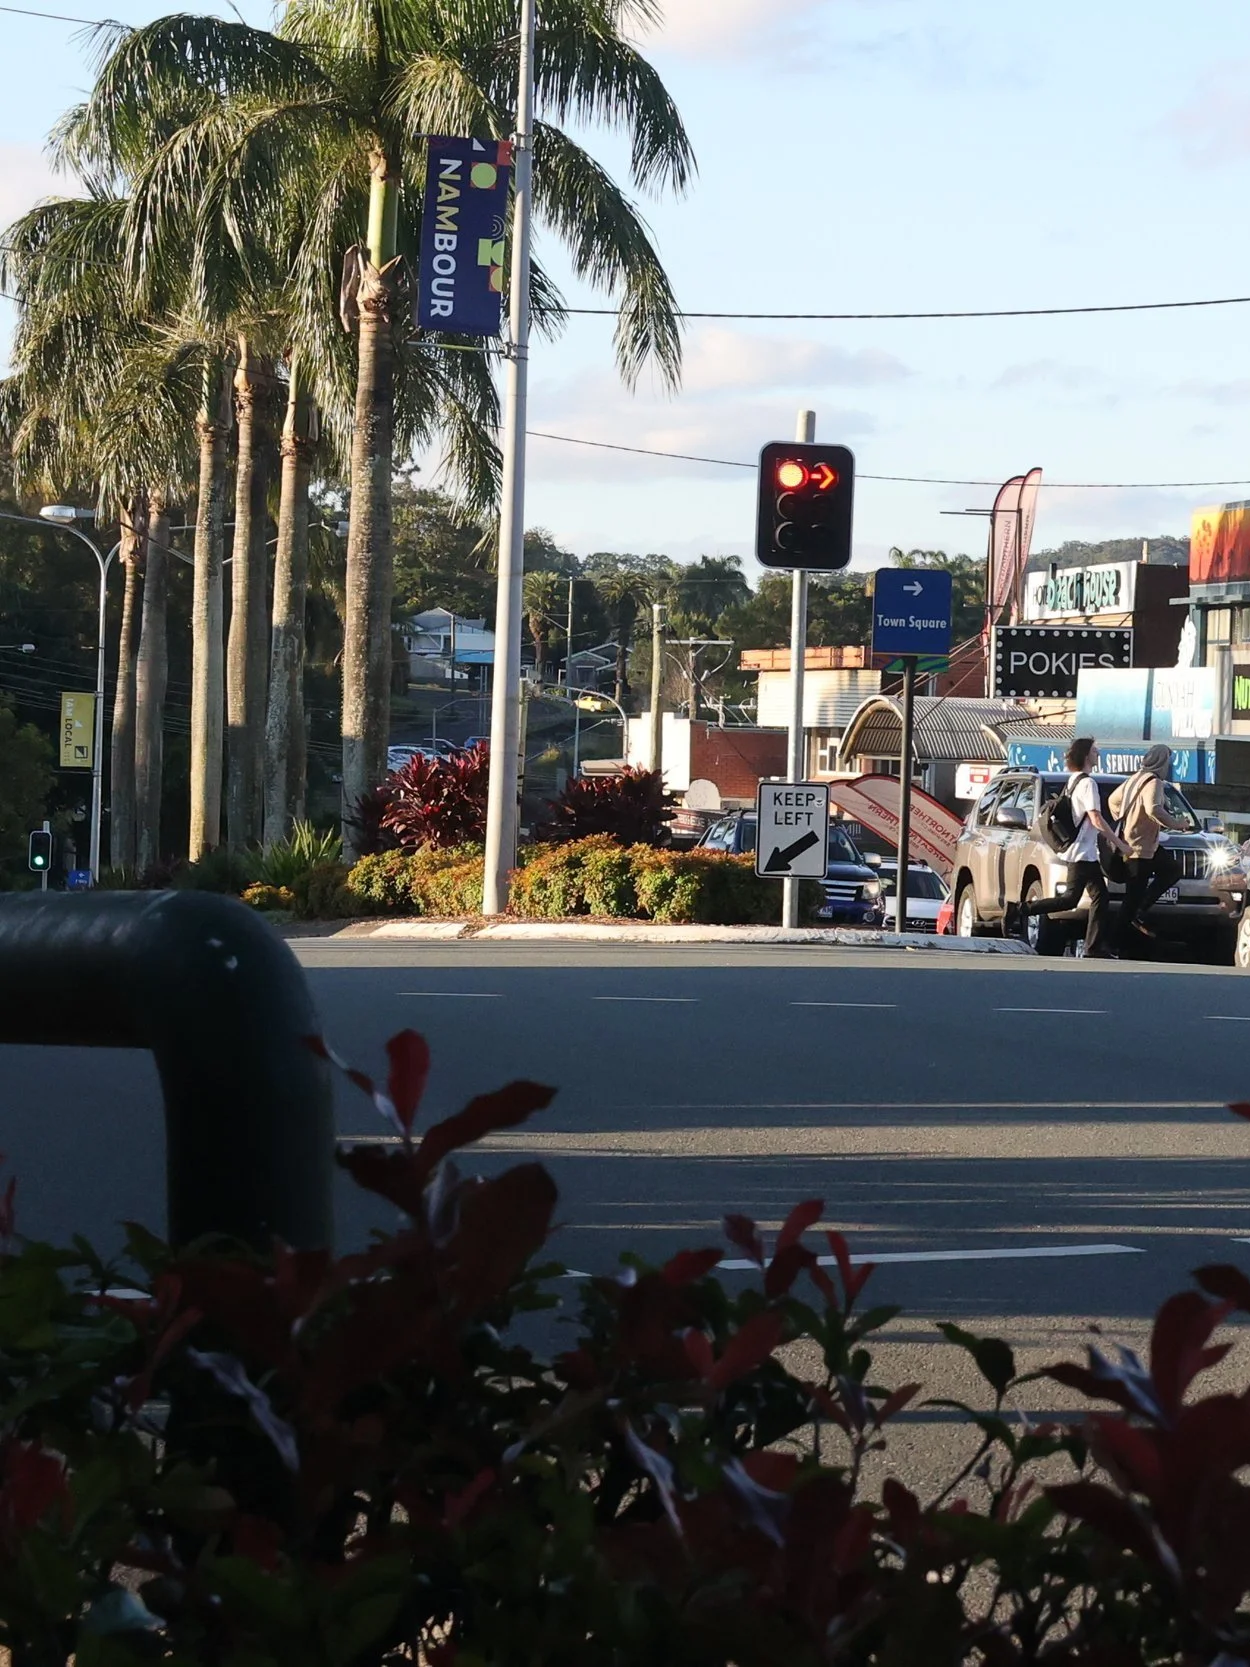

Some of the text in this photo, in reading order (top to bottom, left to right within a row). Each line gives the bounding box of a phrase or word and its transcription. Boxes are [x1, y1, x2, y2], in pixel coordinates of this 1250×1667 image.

[430, 158, 463, 318] NAMBOUR
[877, 614, 947, 631] Town Square
[1009, 652, 1115, 675] POKIES
[64, 718, 73, 748] LOCAL
[773, 792, 816, 807] KEEP
[774, 812, 814, 826] LEFT
